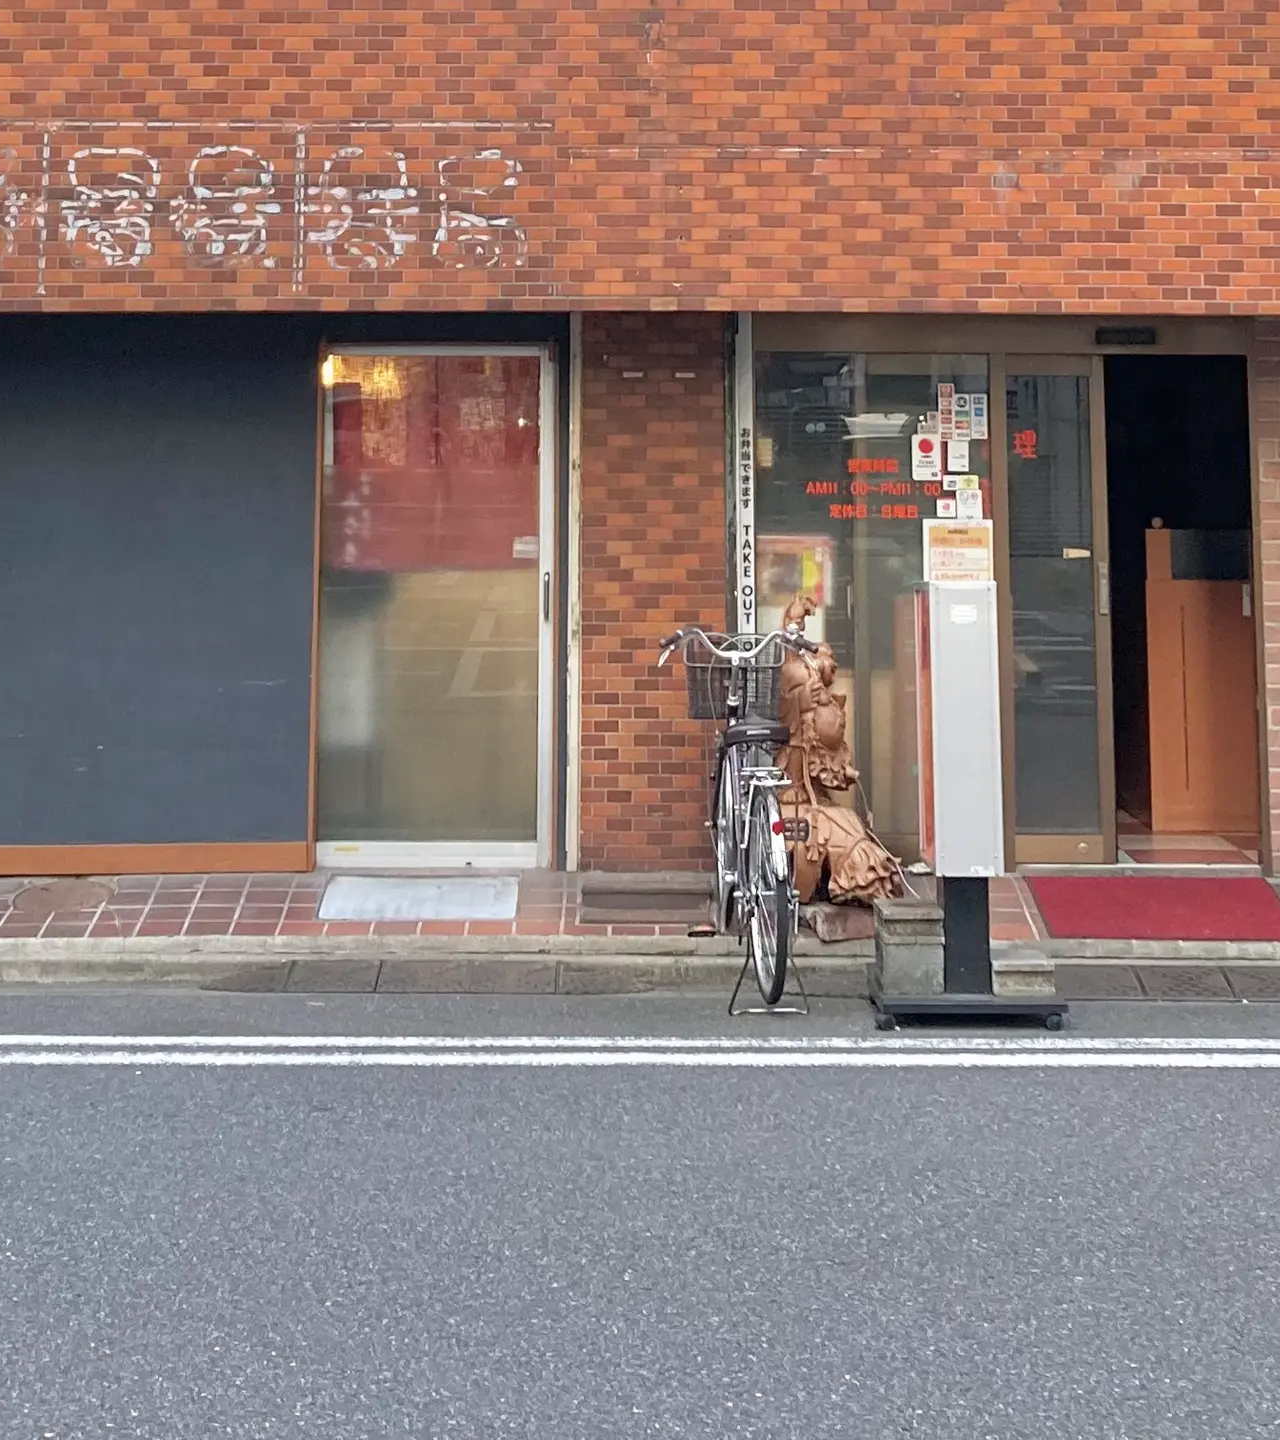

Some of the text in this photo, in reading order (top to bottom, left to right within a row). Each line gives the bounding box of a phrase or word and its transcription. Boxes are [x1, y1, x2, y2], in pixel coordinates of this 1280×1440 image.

[740, 428, 752, 509] お弁当できます
[742, 525, 752, 578] TAKE
[742, 585, 754, 625] OUT
